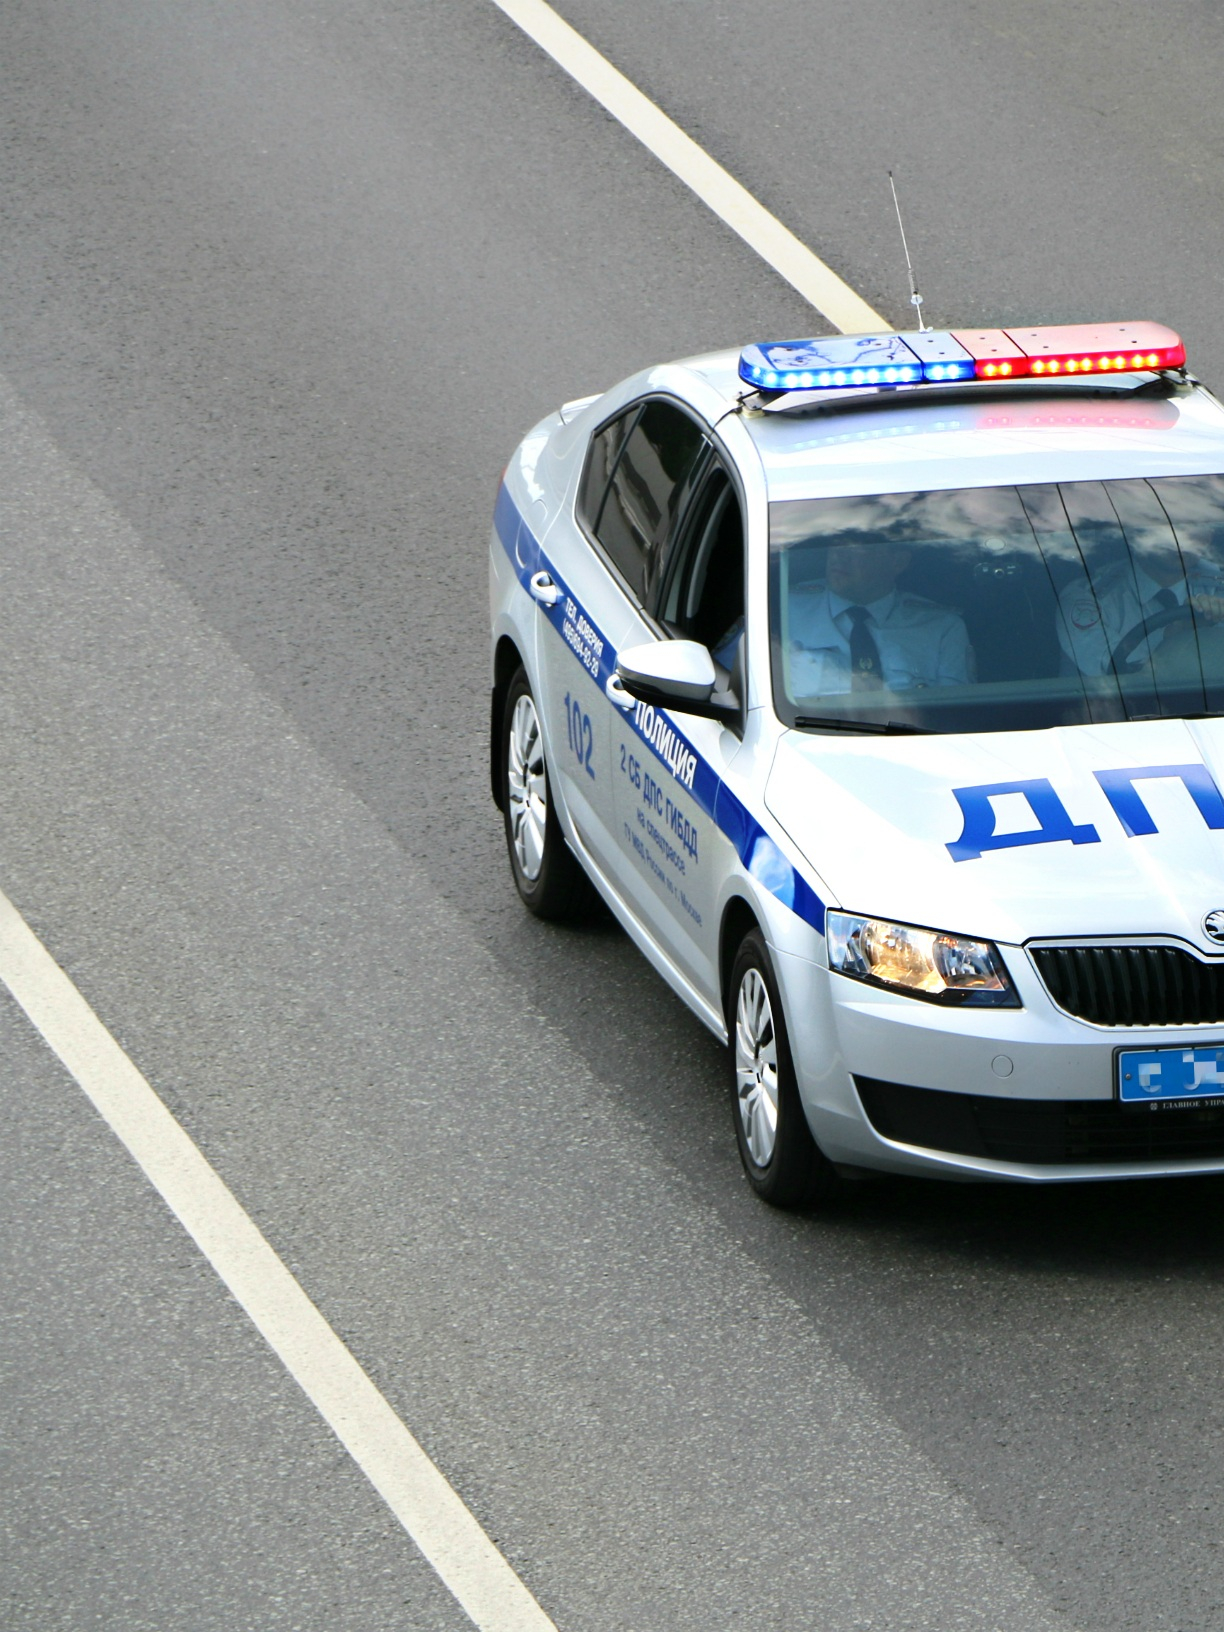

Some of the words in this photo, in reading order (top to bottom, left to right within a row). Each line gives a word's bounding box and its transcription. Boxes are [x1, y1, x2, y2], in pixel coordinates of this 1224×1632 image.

[565, 597, 577, 624] ТЕЛ.
[576, 614, 604, 658] ДОВЕРИЯ
[564, 691, 595, 781] 102
[635, 700, 697, 790] ПОЛИЦИЯ
[620, 744, 627, 774] 2
[628, 753, 641, 790] СБ
[643, 772, 663, 817] ДПС
[665, 797, 699, 865] ГИБДД
[1162, 1101, 1201, 1110] ГЛАВНОЕ
